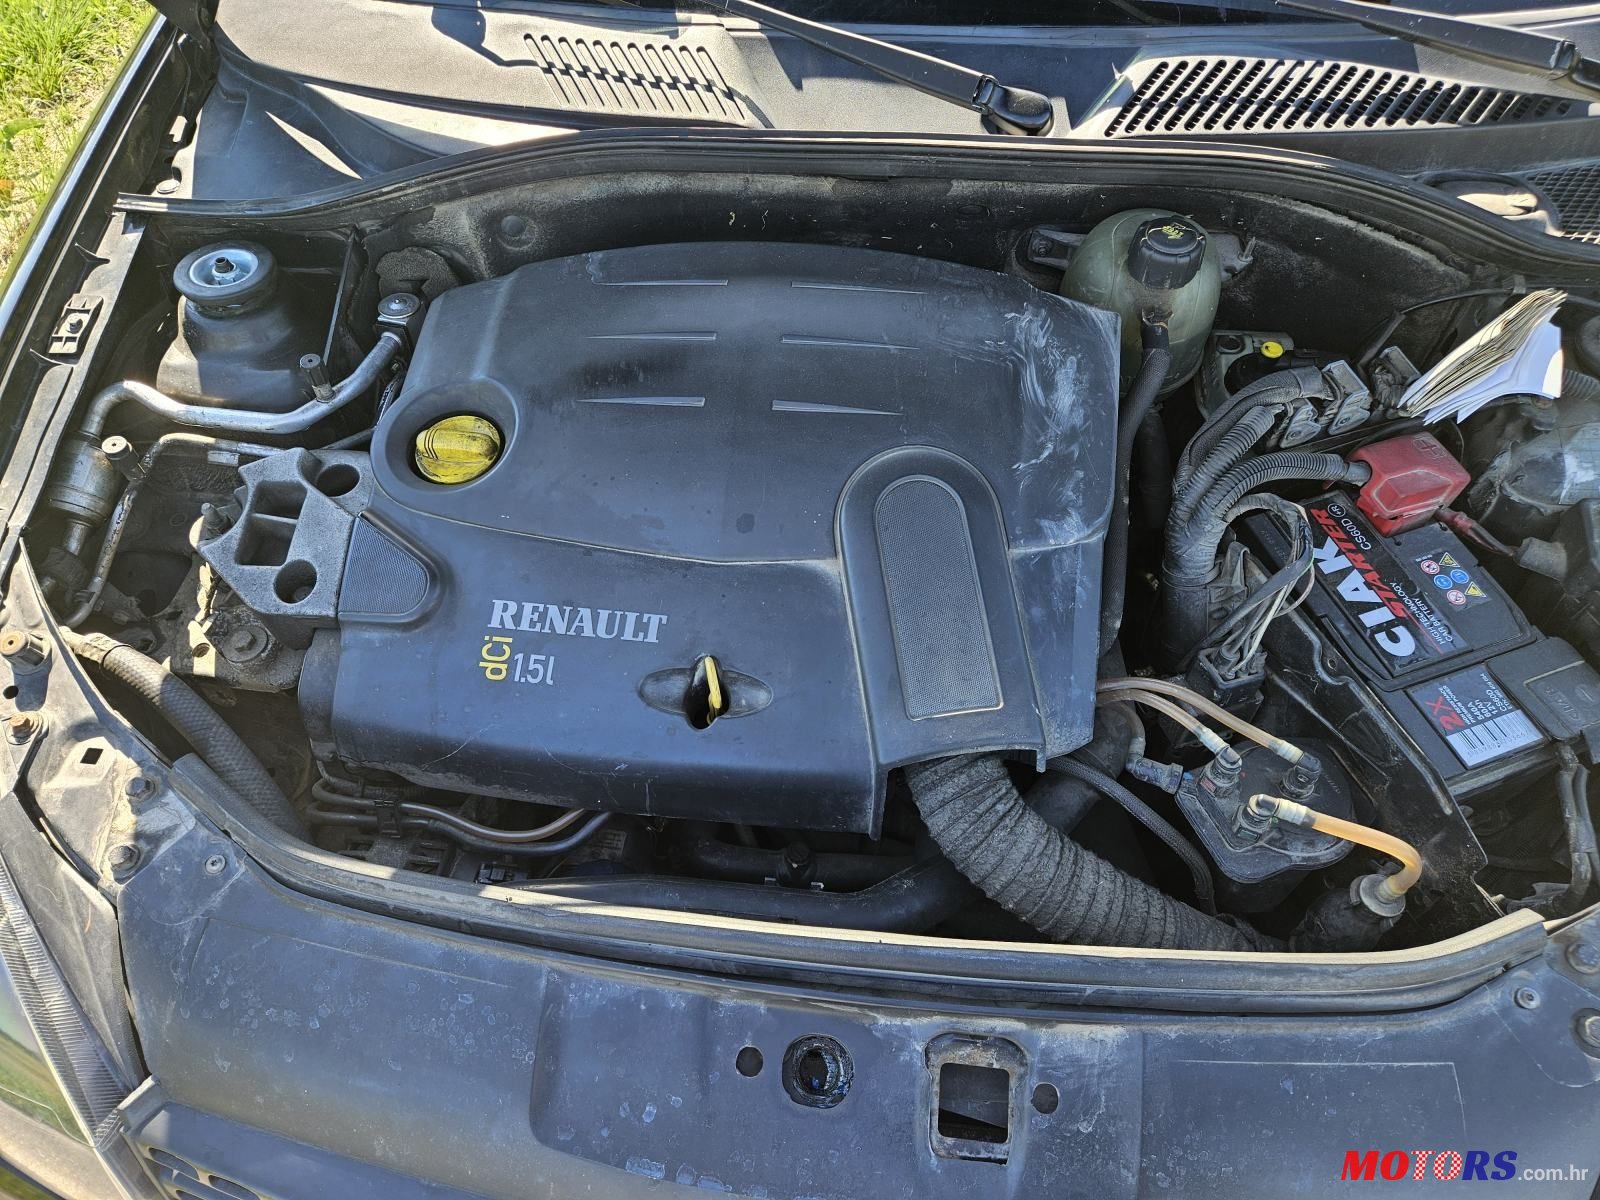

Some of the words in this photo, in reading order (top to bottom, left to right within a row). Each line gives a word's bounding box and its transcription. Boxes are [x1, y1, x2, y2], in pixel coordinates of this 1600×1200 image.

[1340, 516, 1372, 550] CS60D
[1309, 507, 1410, 618] STARTER
[1312, 535, 1417, 656] CIAK
[1388, 580, 1430, 626] TECHNOLOGY
[487, 599, 668, 644] RENAULT
[1412, 596, 1441, 626] BATTERY
[1426, 625, 1445, 645] HIGH
[1436, 625, 1453, 642] CAR
[478, 635, 513, 682] dCi
[1442, 684, 1459, 701] POWER
[1484, 688, 1507, 712] CS60D
[1423, 695, 1466, 731] 2X
[1456, 700, 1476, 722] PREMIUM
[1466, 700, 1485, 720] 540A
[1473, 698, 1492, 717] 60Ah
[1482, 701, 1499, 714] 12V
